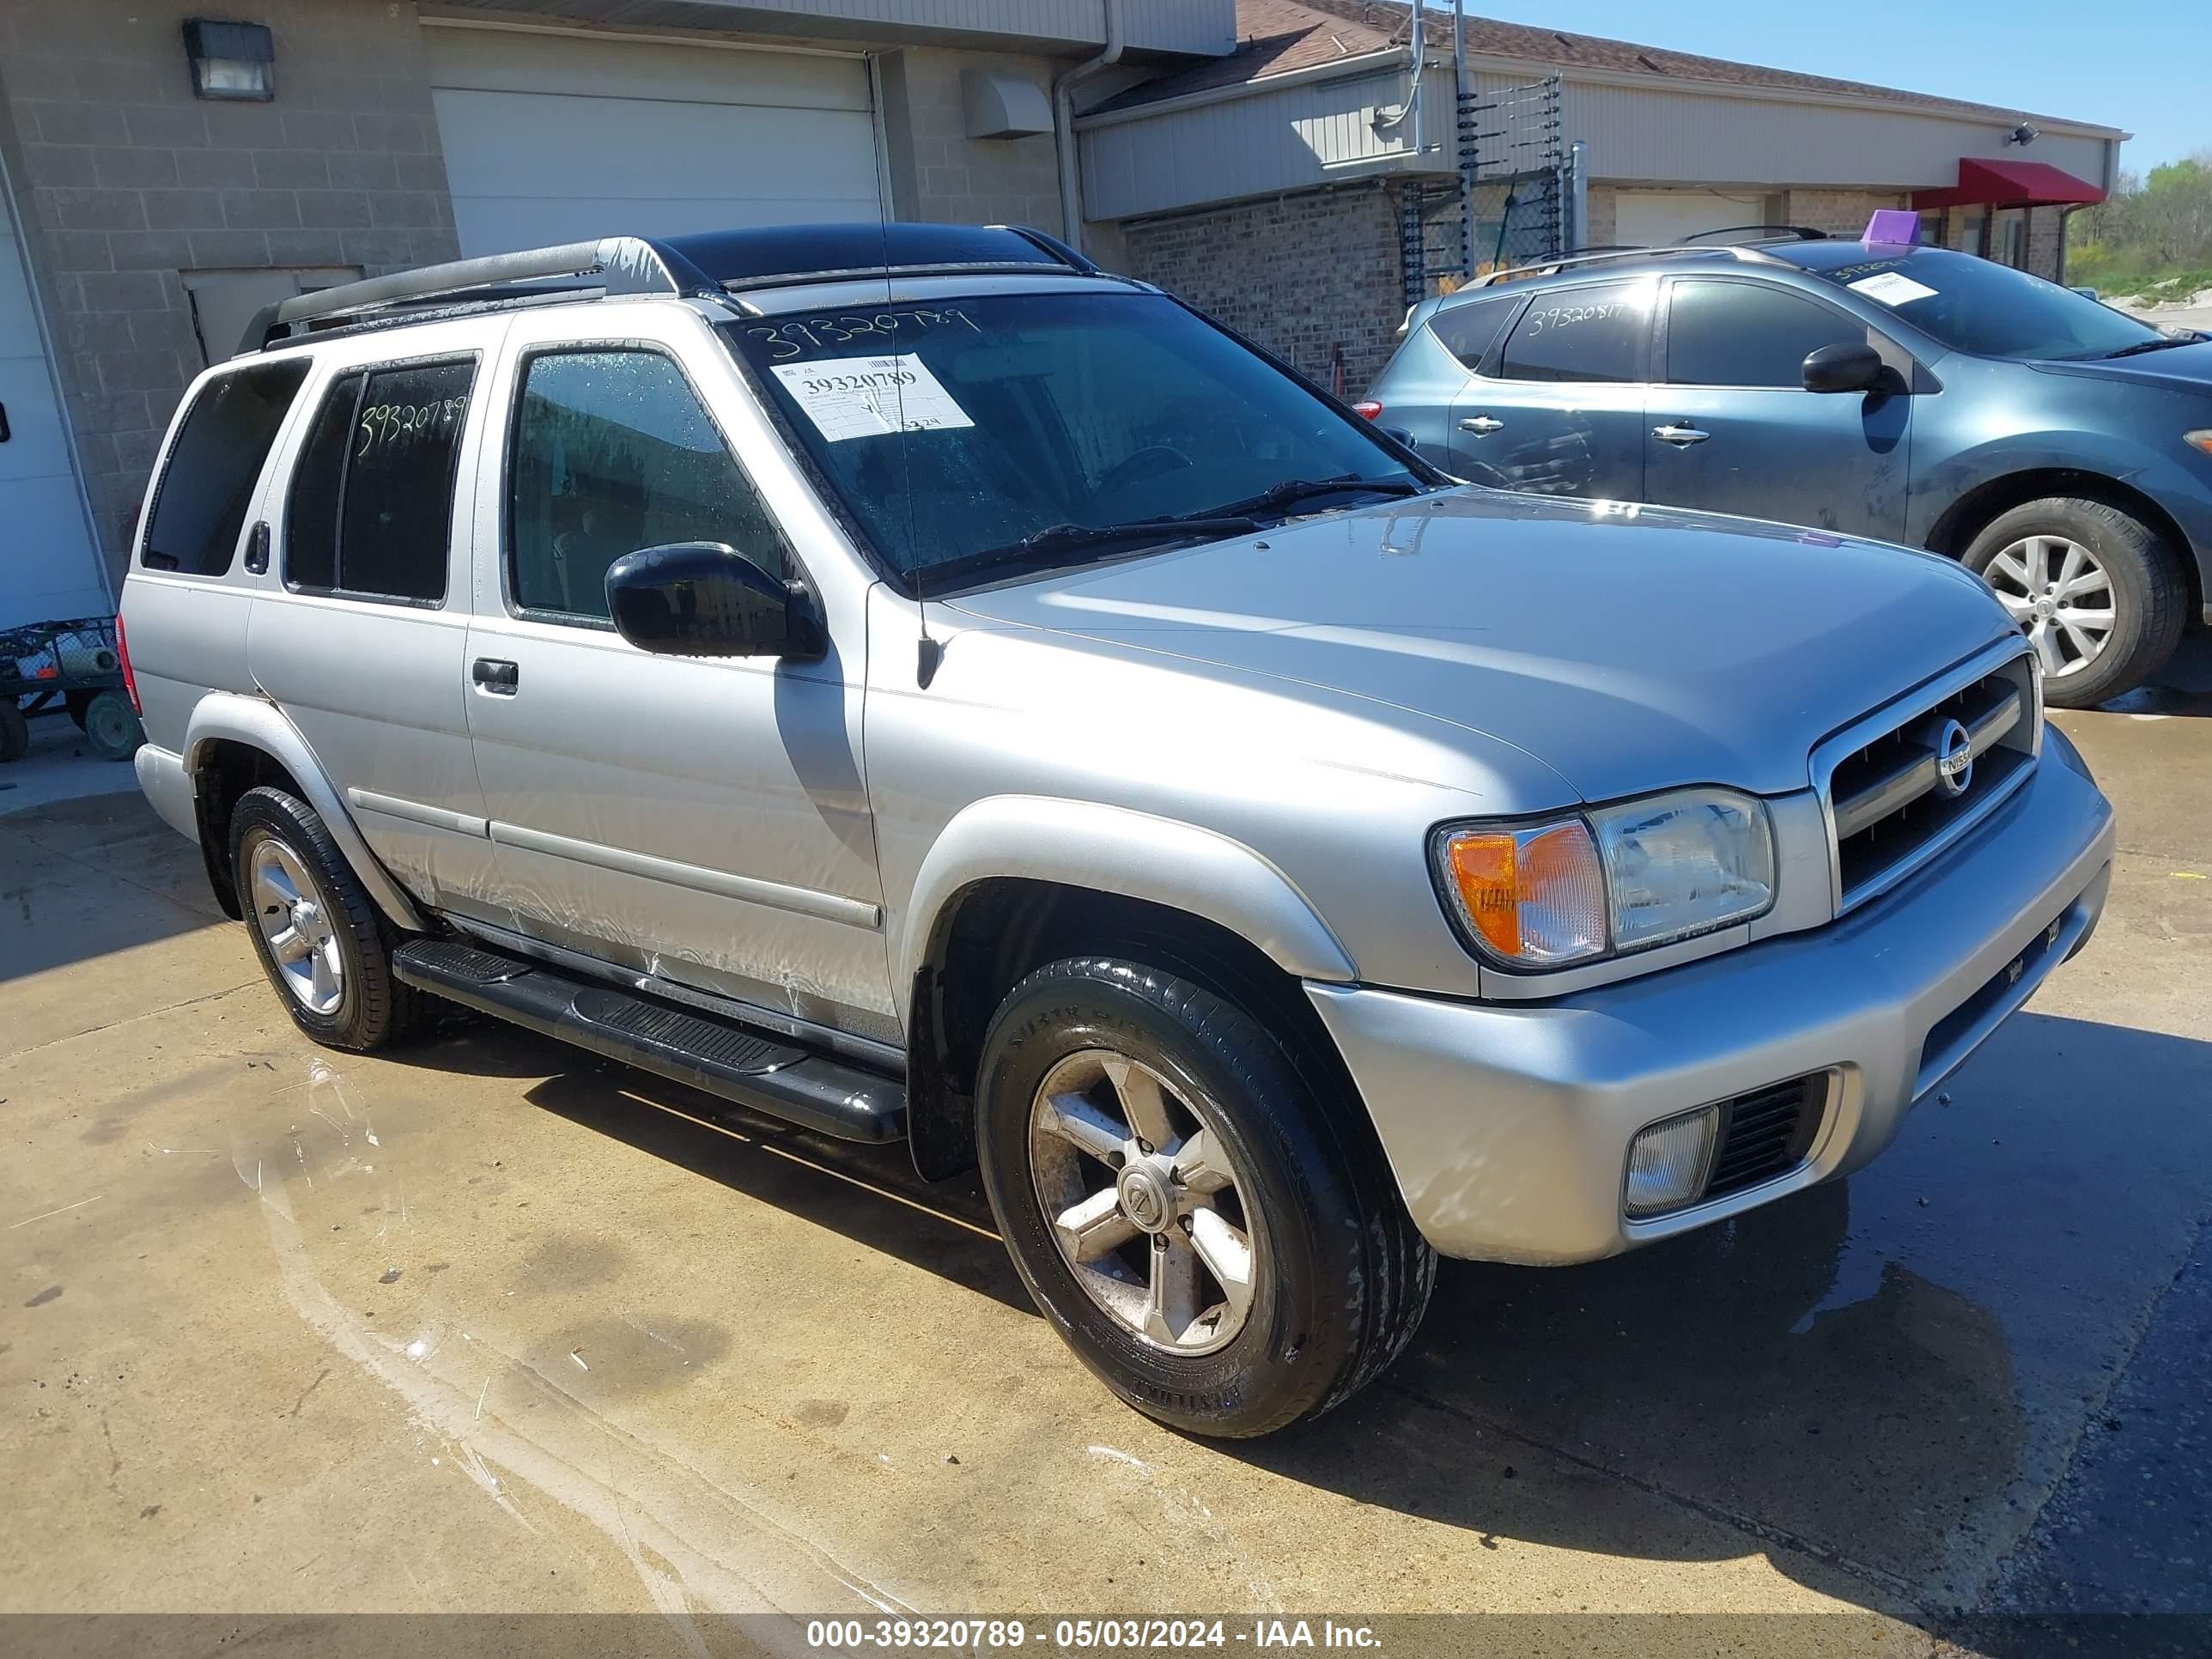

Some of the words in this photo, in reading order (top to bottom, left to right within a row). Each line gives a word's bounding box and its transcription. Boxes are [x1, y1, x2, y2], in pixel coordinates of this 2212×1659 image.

[747, 310, 981, 357] 39320789
[1529, 304, 1625, 337] 39320817
[802, 371, 916, 394] 39320789
[358, 396, 467, 457] 39320789
[1948, 747, 1972, 771] NISS
